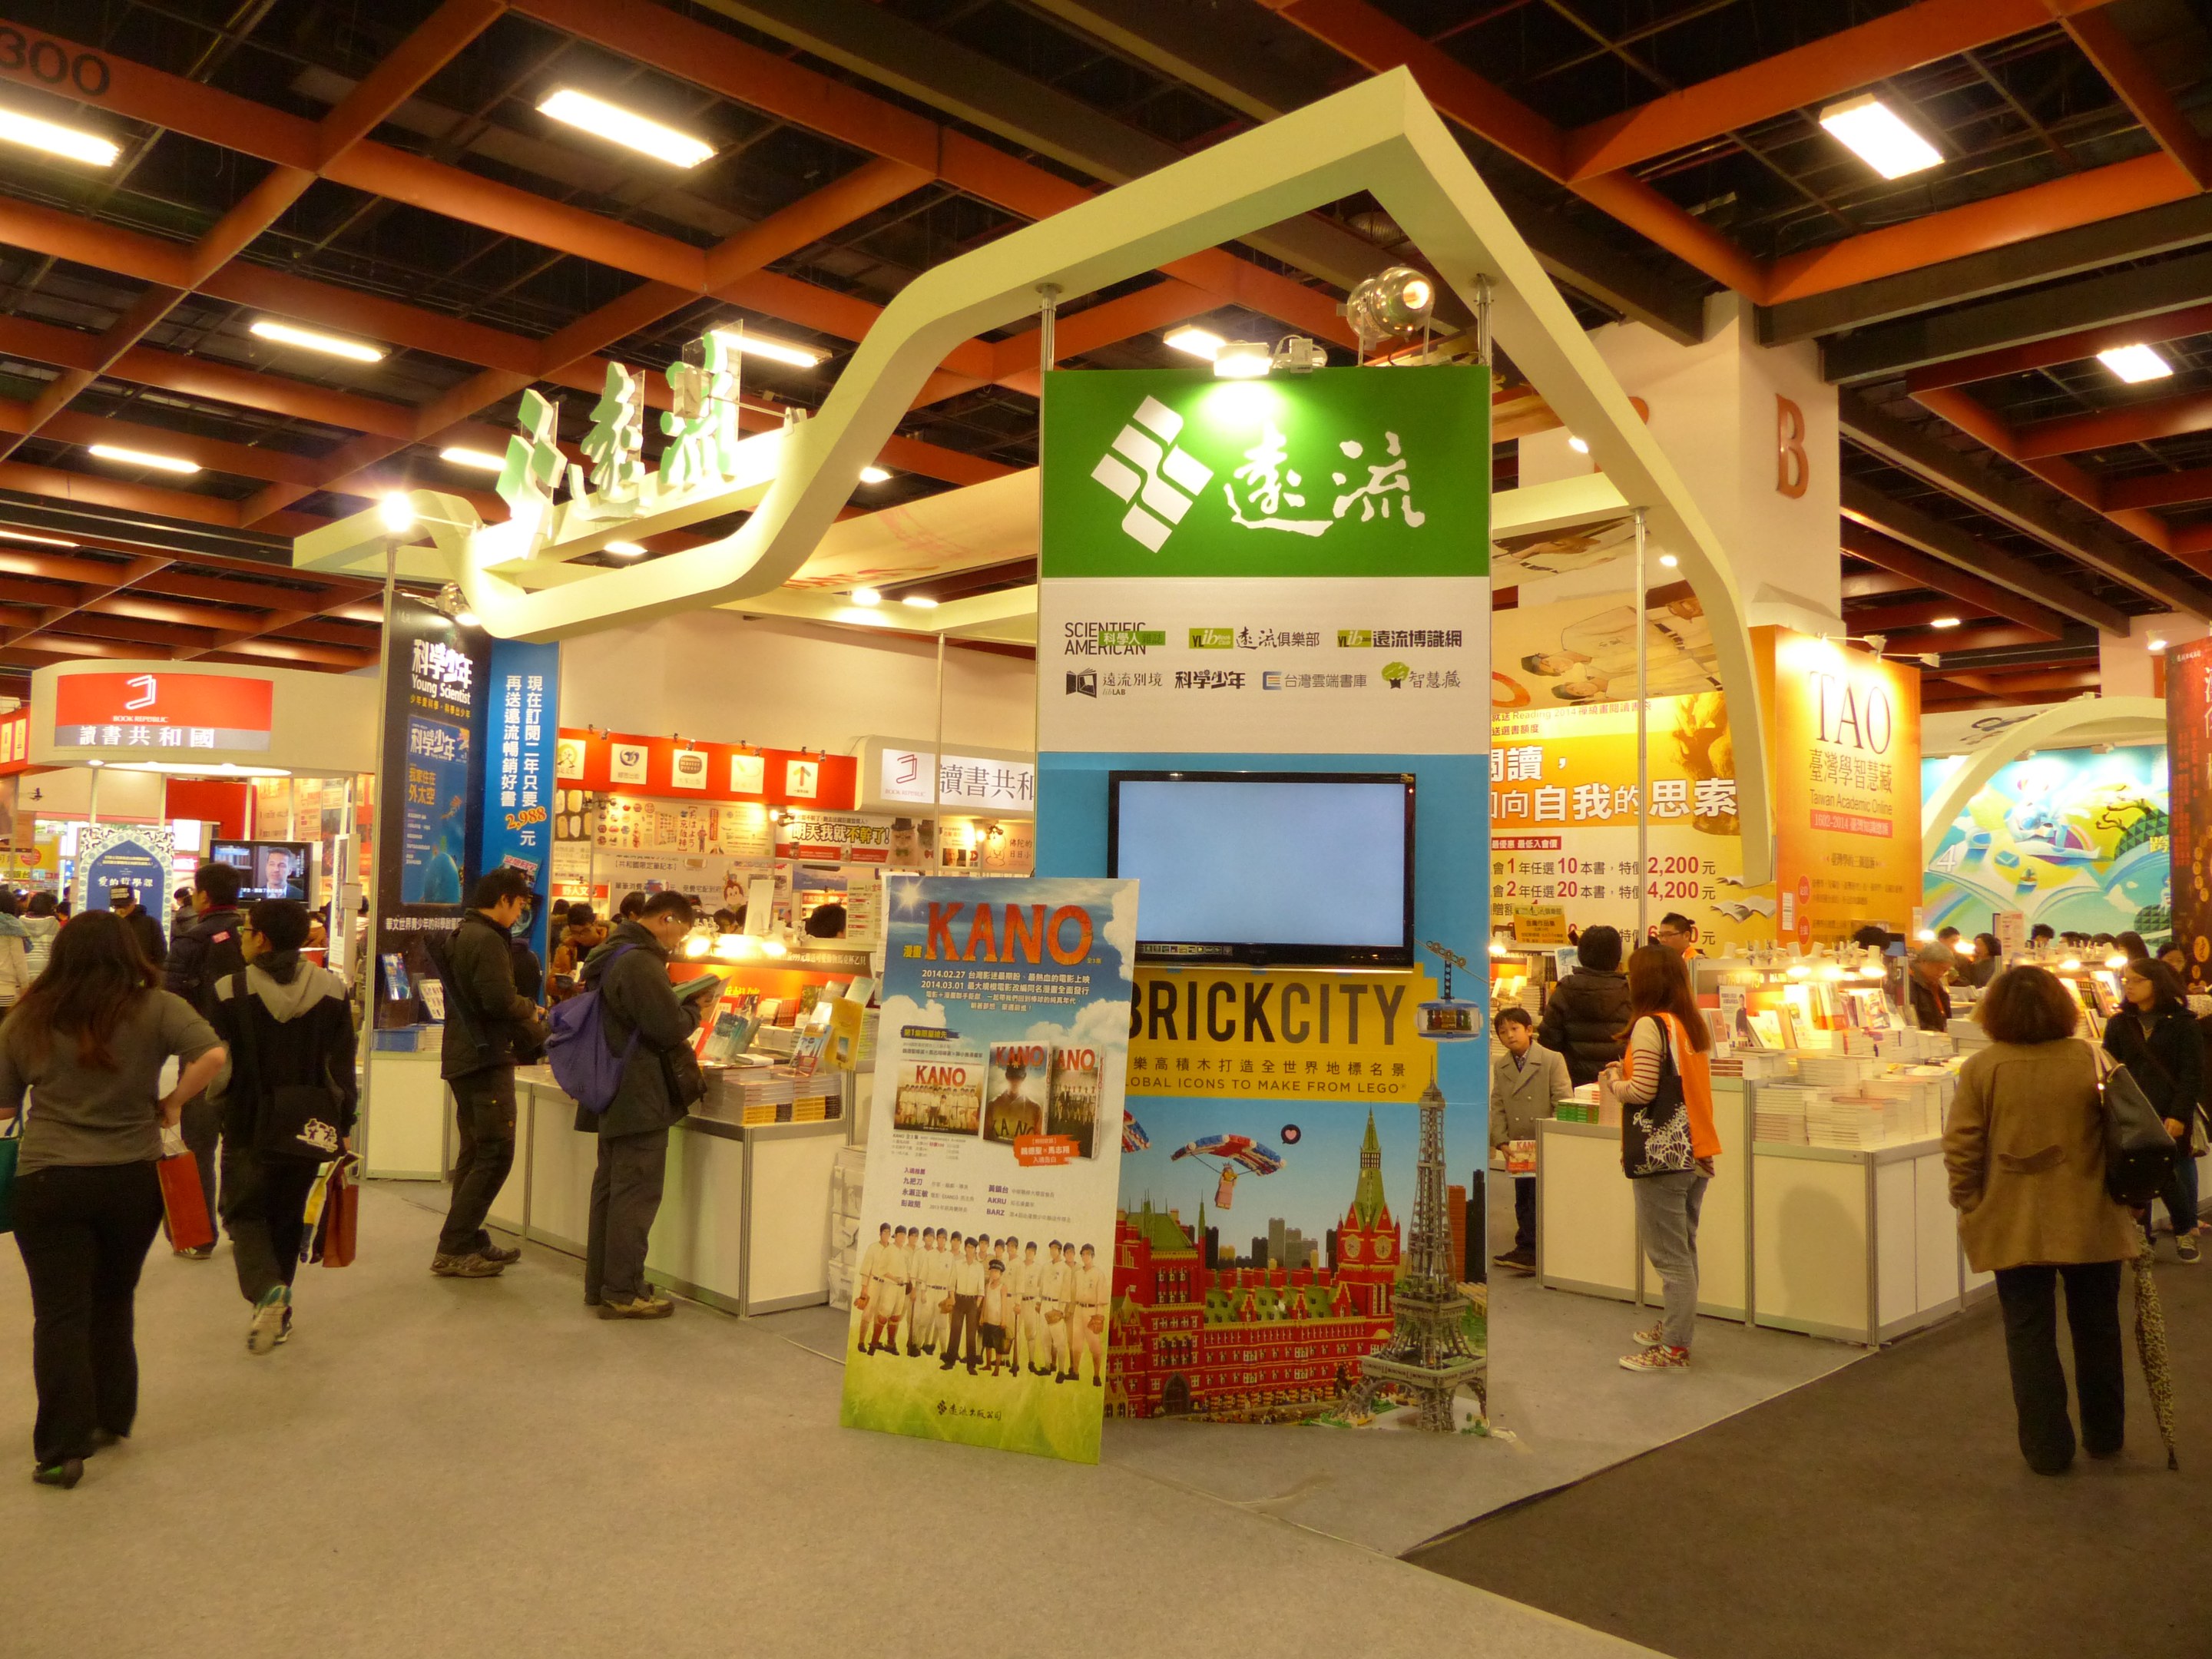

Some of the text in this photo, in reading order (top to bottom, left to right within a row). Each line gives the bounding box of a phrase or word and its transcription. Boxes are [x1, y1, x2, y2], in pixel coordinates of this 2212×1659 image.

[0, 27, 111, 96] 300
[1776, 393, 1810, 499] B
[1224, 420, 1426, 538] 遠流
[1373, 629, 1462, 648] 遠流博識網
[412, 673, 471, 705] Young Scientist
[1103, 671, 1164, 687] 遠流別境
[1174, 669, 1247, 690] 科學少年
[1284, 673, 1367, 688] 台灣雲端書庫
[1409, 670, 1461, 689] 智慧藏
[1513, 708, 1552, 720] Reading
[1555, 707, 1577, 717] 2014
[1809, 671, 1892, 755] TAO
[80, 726, 215, 749] 讀書共和國
[501, 675, 522, 807] 再送遠流暢銷好書
[522, 675, 544, 807] 現在訂閱二年只要
[1809, 748, 1892, 796] 臺灣學智慧藏
[1491, 777, 1737, 823] 向自我的思索
[1810, 788, 1892, 816] Taiwan Academic Online
[505, 806, 547, 830] 2,988
[1813, 813, 1849, 830] 1602-2014
[520, 830, 536, 846] 元
[1647, 856, 1699, 876] 2,200
[1647, 881, 1699, 900] 4,200
[925, 901, 1094, 966] KANO
[921, 980, 965, 990] 2014.03.01
[922, 969, 965, 979] 2014.02.27
[995, 1045, 1045, 1068] KANO
[1133, 1056, 1407, 1078] 樂高積木打造全世界地標名景
[915, 1065, 966, 1087] KANO
[1125, 1077, 1171, 1088] OBAL
[1178, 1078, 1225, 1090] ICONS
[1231, 1078, 1251, 1091] TO
[1258, 1080, 1301, 1091] MAKE
[1307, 1081, 1351, 1094] FROM
[987, 1195, 1007, 1205] AKRU
[986, 1207, 1005, 1217] BARZ
